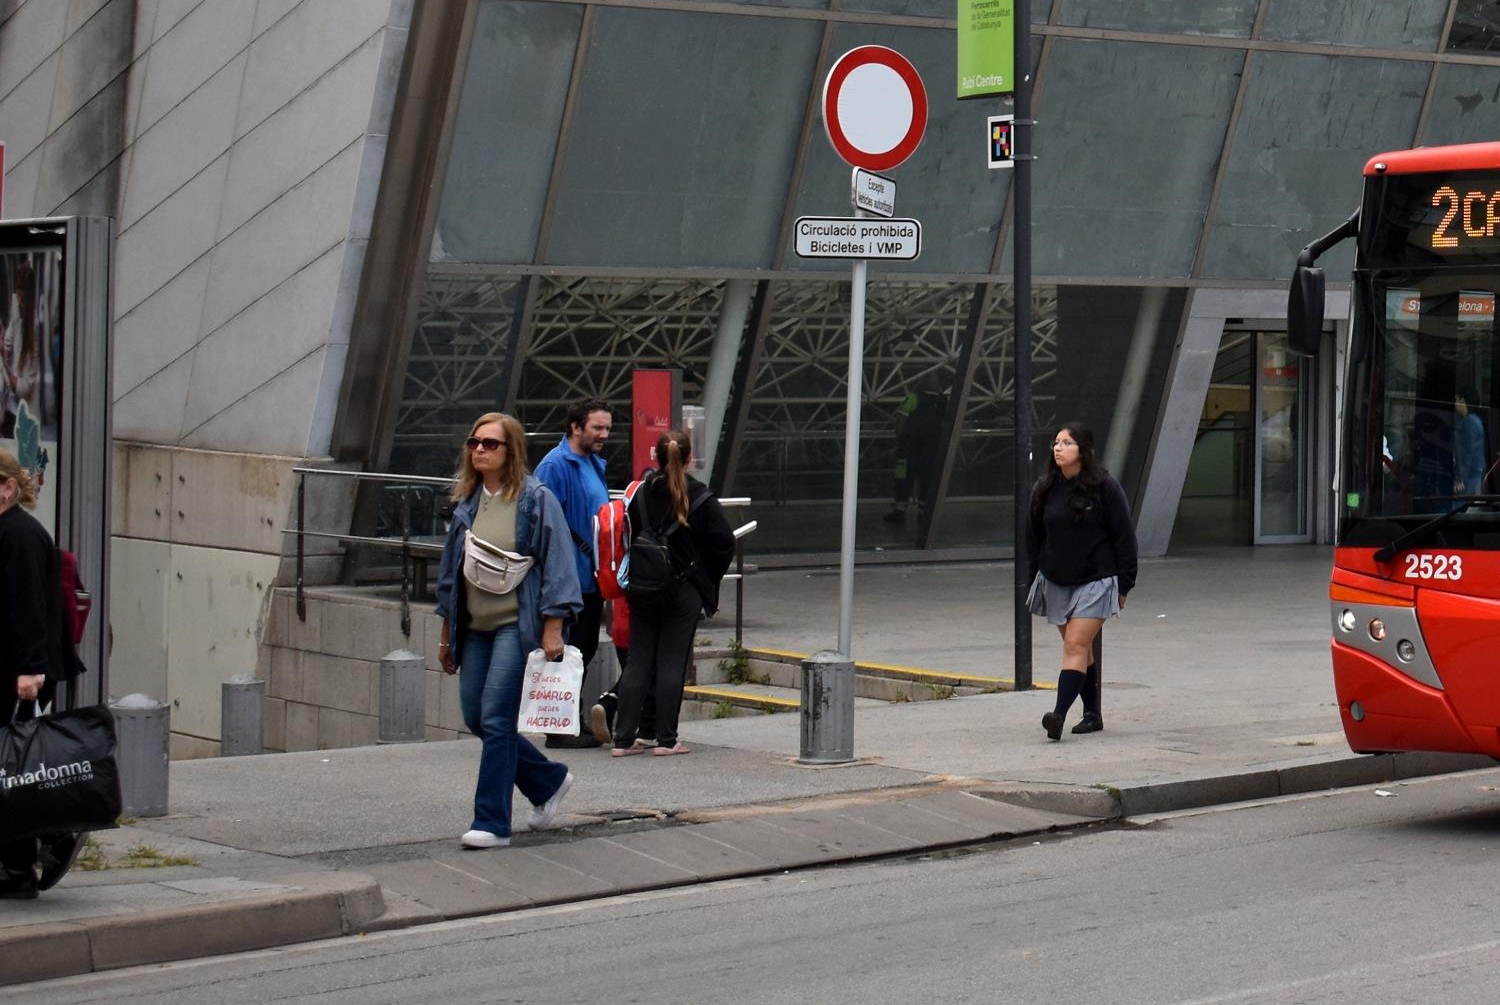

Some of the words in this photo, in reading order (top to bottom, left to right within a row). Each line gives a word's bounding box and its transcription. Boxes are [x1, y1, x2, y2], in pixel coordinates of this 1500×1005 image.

[976, 74, 1003, 88] Centre
[1431, 185, 1459, 248] 2
[800, 223, 857, 236] Circulació
[861, 226, 914, 239] prohibida
[810, 241, 864, 253] Bicicletes
[869, 242, 872, 254] i
[877, 242, 903, 254] VMP
[1458, 301, 1483, 312] elona
[1405, 554, 1463, 580] 2523
[527, 716, 571, 728] HACERLO
[38, 773, 94, 790] COLLECTION
